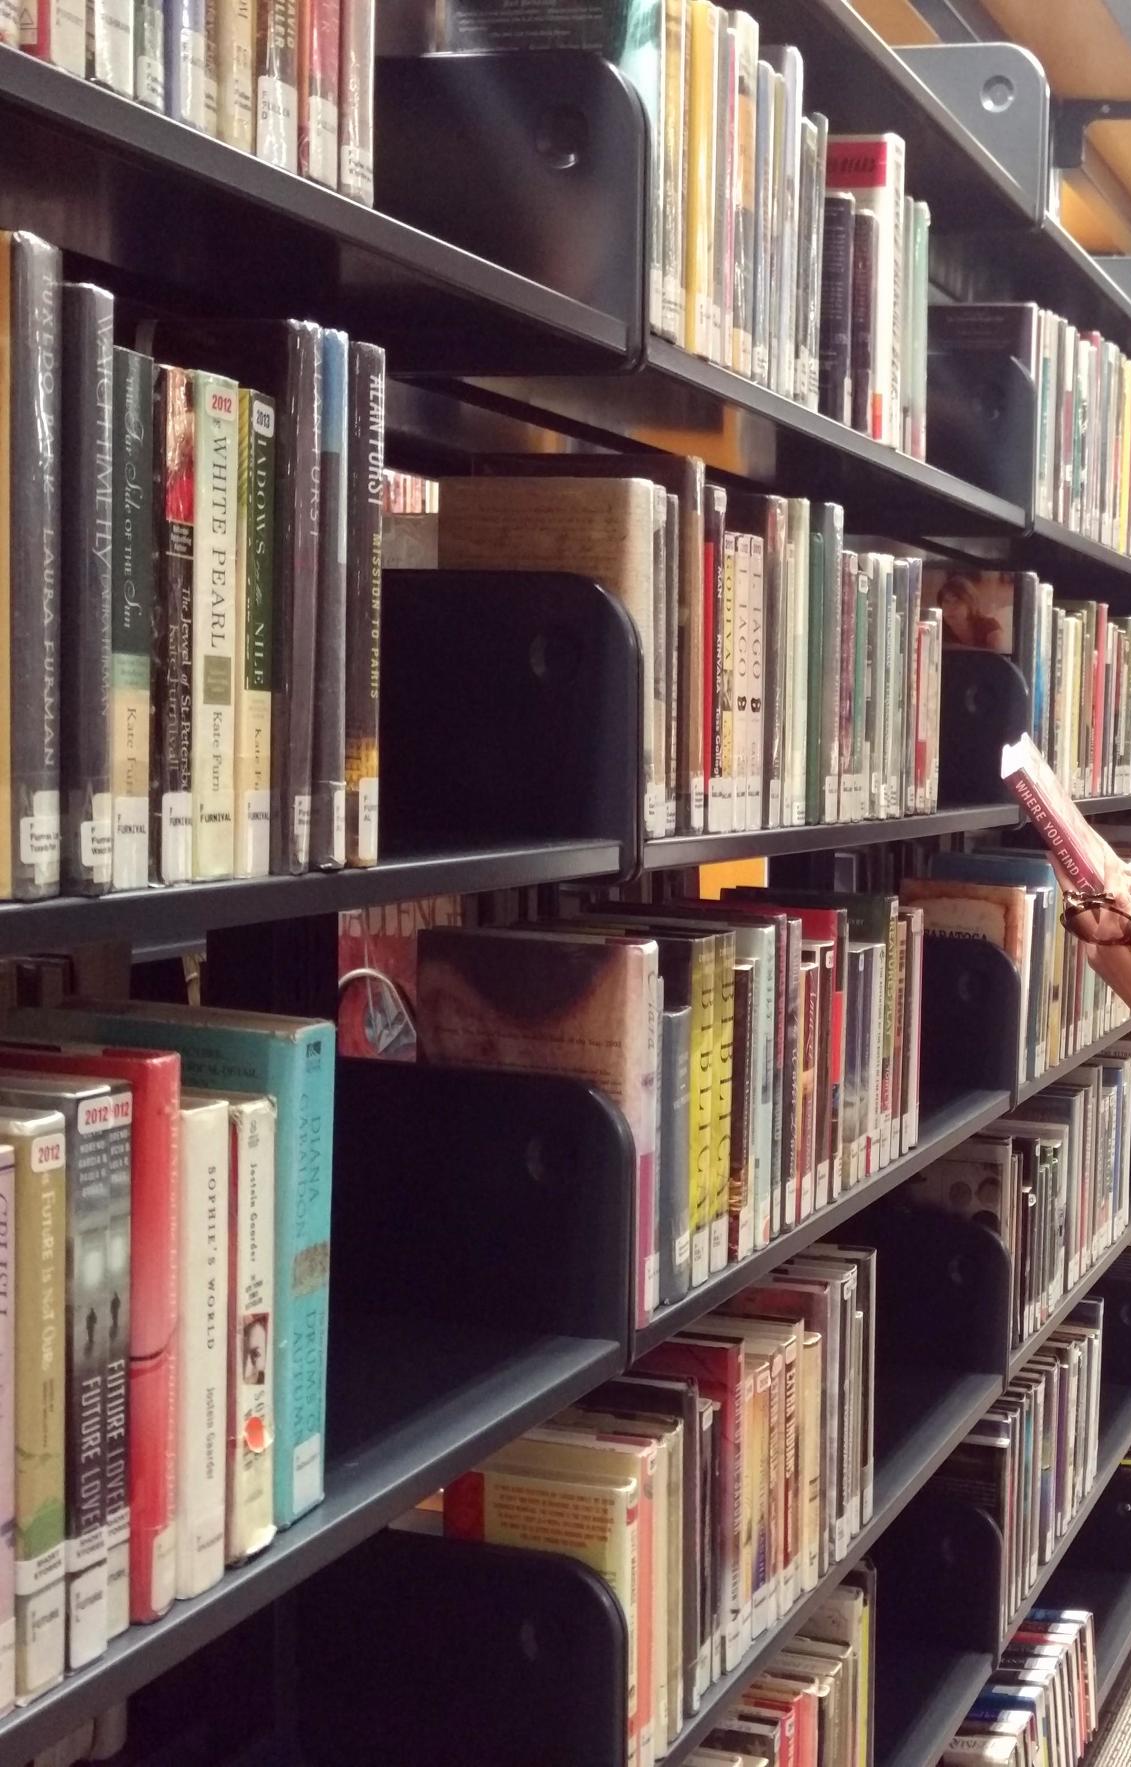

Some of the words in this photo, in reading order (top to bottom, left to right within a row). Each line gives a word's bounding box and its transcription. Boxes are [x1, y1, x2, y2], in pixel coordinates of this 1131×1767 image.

[42, 275, 55, 395] TUXEDO
[211, 394, 232, 413] 2012
[255, 409, 271, 429] 2013
[369, 375, 382, 432] ALAN
[211, 437, 227, 535] WHITE
[368, 440, 382, 506] FURST
[124, 519, 133, 541] OF
[43, 528, 55, 627] LAURA
[123, 546, 132, 576] THE
[372, 533, 381, 609] MISSION
[123, 580, 143, 629] Sun
[181, 586, 191, 611] The
[211, 547, 227, 648] PEARL
[725, 554, 734, 660] GODIVA
[181, 612, 192, 666] Jewel
[254, 622, 264, 685] NILE
[371, 620, 380, 640] TO
[738, 604, 748, 677] IAGO
[752, 607, 762, 680] IAGO
[181, 673, 191, 686] of
[370, 647, 380, 700] PARIS
[43, 640, 56, 766] FURMAN
[126, 707, 137, 749] Kate
[212, 711, 223, 744] Kate
[117, 824, 147, 835] FURNIVAL
[200, 813, 232, 824] FURNIVAL
[1015, 779, 1047, 822] WHERE
[1043, 821, 1064, 848] YOU
[1056, 848, 1081, 876] FIND
[1076, 877, 1090, 893] IT
[647, 970, 658, 1050] Clara
[85, 1106, 109, 1126] 2012
[112, 1101, 130, 1119] 012
[38, 1144, 61, 1164] 2012
[295, 1093, 309, 1239] GABALDON
[308, 1115, 321, 1202] DIANA
[250, 1163, 259, 1209] Jostein
[42, 1190, 56, 1260] FUTURE
[207, 1165, 218, 1267] SOPHIE'S
[250, 1211, 259, 1263] Gaarder
[207, 1277, 217, 1350] WORLD
[305, 1309, 317, 1405] DRUMS
[81, 1376, 102, 1464] FUTURE
[106, 1359, 125, 1441] FUTURE
[206, 1386, 217, 1431] Jostein
[784, 1370, 796, 1418] EXTRA
[206, 1432, 217, 1480] Gaarder
[784, 1420, 796, 1479] INDIANS
